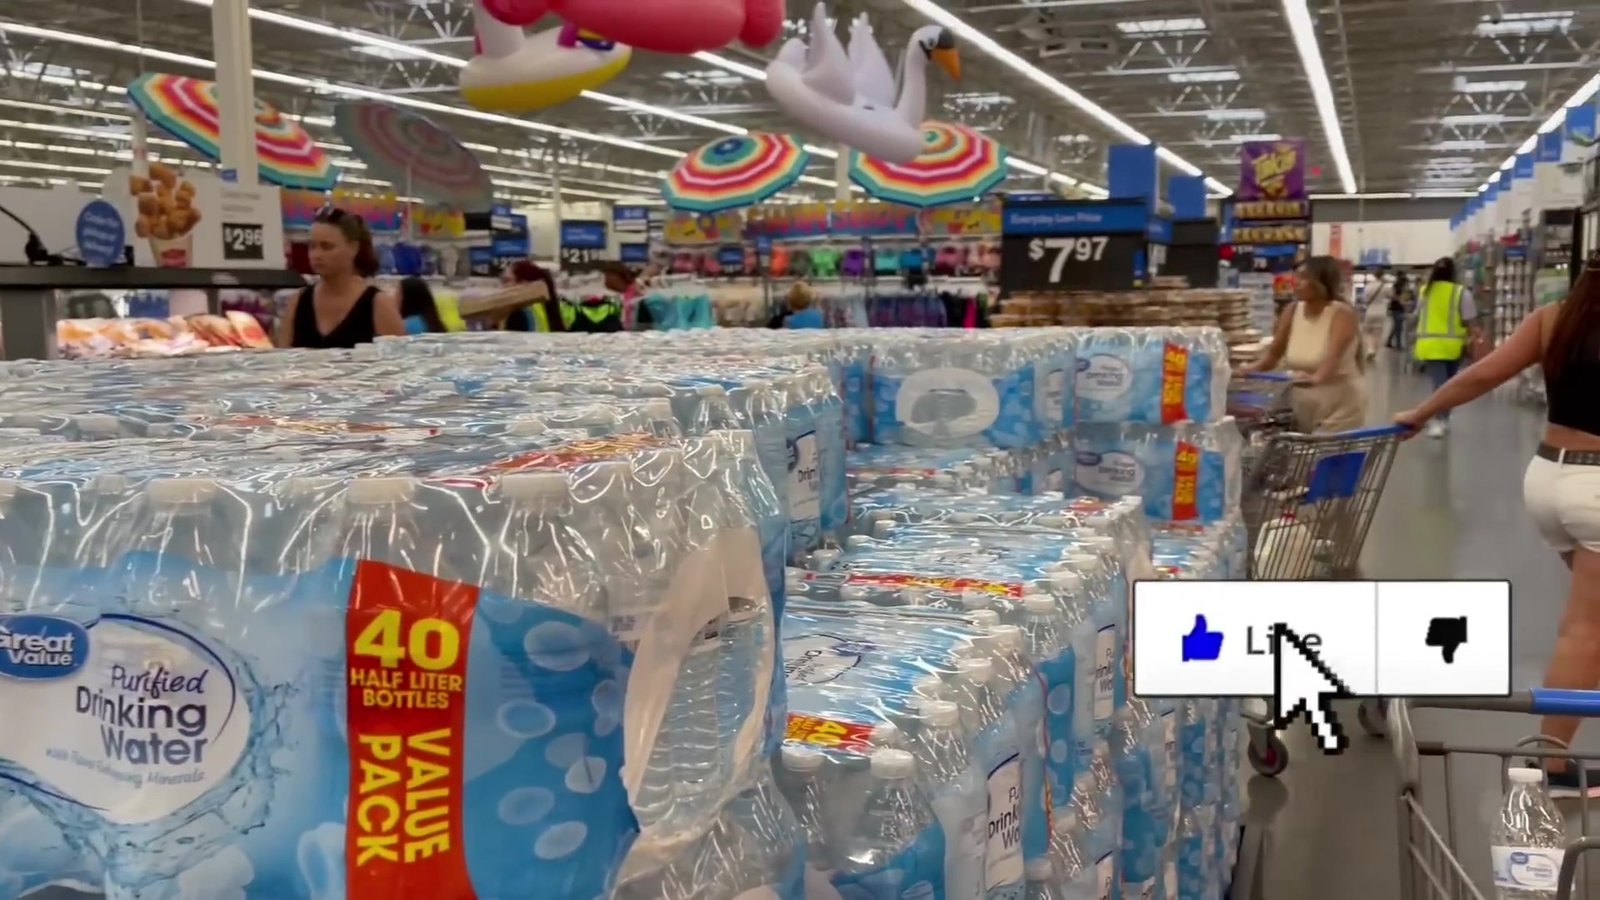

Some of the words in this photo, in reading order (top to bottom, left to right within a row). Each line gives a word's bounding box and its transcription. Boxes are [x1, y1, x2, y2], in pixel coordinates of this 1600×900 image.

[1028, 236, 1109, 283] $797
[9, 648, 73, 666] Value
[354, 609, 460, 670] 40
[111, 664, 209, 699] Purified
[350, 667, 404, 689] HALF
[410, 671, 462, 692] LITER
[363, 688, 449, 709] BOTTLES
[76, 686, 207, 737] Drinking
[101, 724, 207, 765] Water
[356, 733, 402, 867] PACK
[404, 728, 452, 863] VALUE
